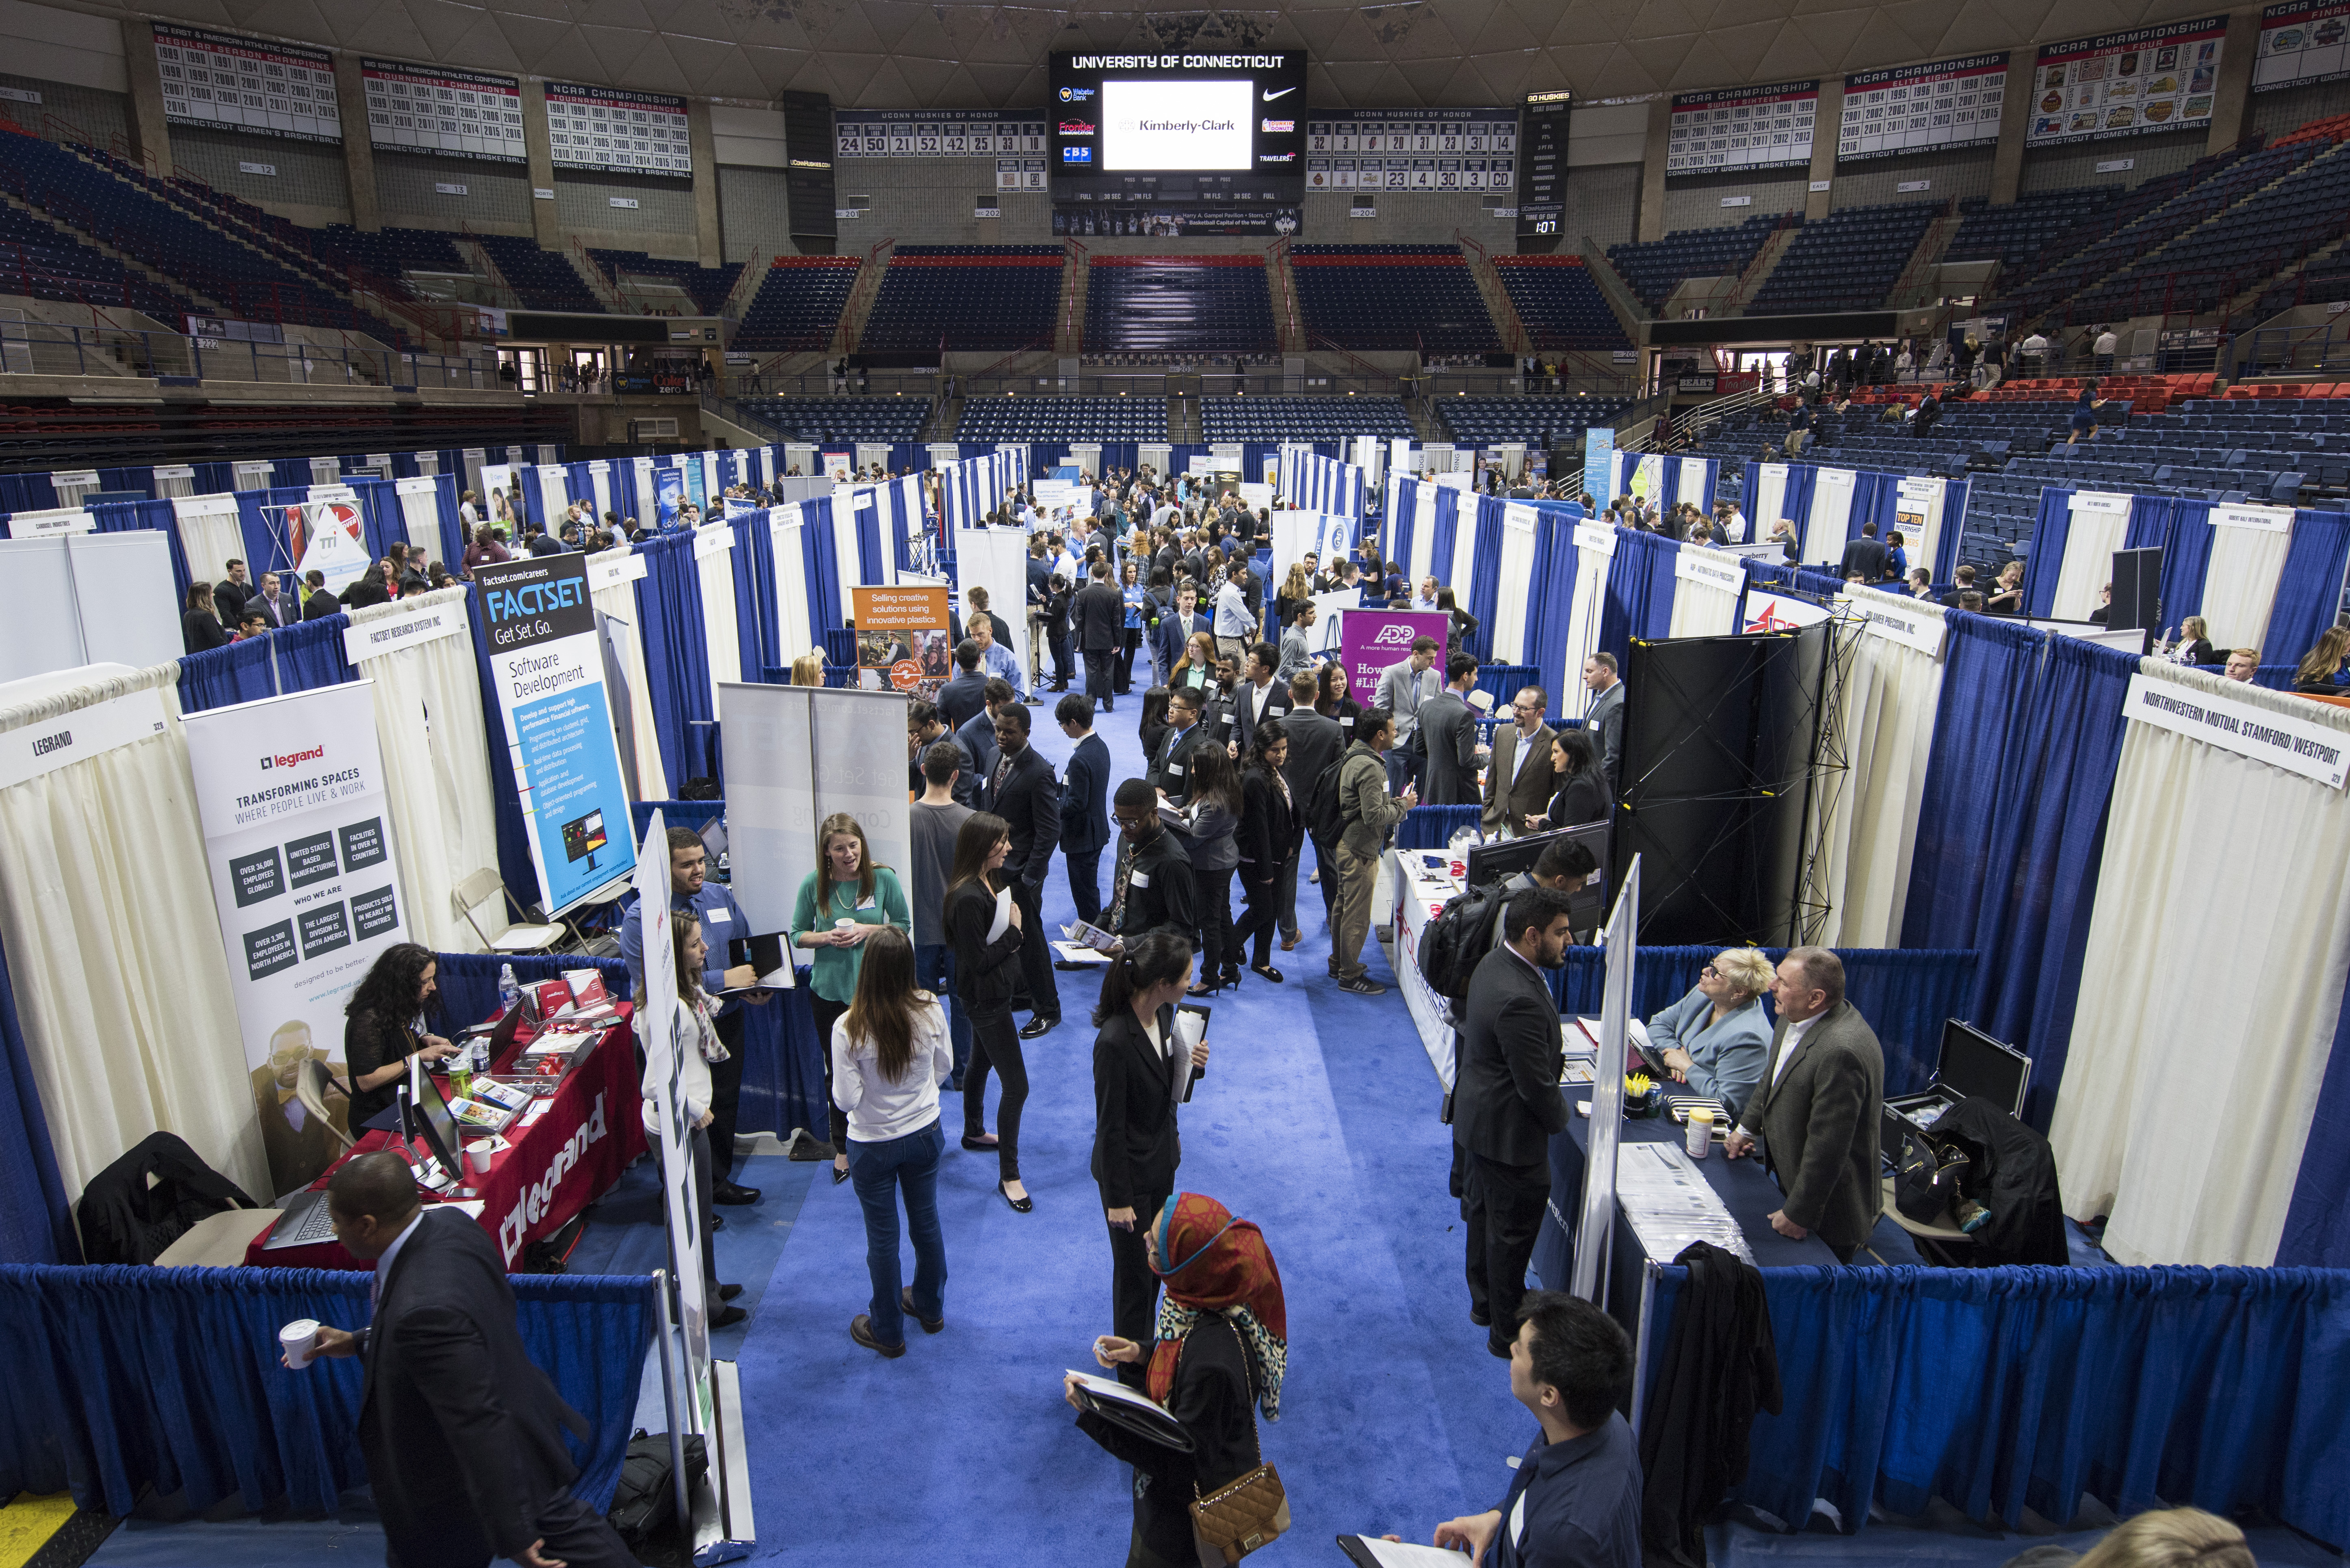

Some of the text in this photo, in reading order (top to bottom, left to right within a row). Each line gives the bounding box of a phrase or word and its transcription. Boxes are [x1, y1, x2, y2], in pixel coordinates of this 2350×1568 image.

[2049, 19, 2216, 54] NCAA CHAMPIONSHIP
[158, 37, 329, 70] REGULAR SEASON CHAMPIONS
[204, 34, 243, 45] AMERICAN
[245, 41, 280, 52] ATHLETIC
[283, 48, 328, 60] CONFERENCE
[2094, 40, 2163, 57] FINAL FOUR
[1073, 56, 1284, 68] UNIVERSITY OF CONNECTICUT
[1855, 56, 1999, 84] NCAA CHAMPIONSHIP
[1893, 73, 1955, 87] ELITE EIGHT
[553, 85, 678, 105] NCAA CHAMPIONSHIP
[1059, 122, 1095, 132] Frontier
[1140, 120, 1235, 133] Kimberly-Clark
[841, 138, 858, 151] 24
[867, 138, 884, 151] 50
[896, 138, 910, 151] 21
[921, 138, 937, 150] 52
[947, 138, 964, 150] 42
[975, 138, 988, 150] 25
[1003, 137, 1013, 150] 33
[1030, 137, 1038, 150] 10
[1536, 221, 1556, 233] 1:07
[654, 374, 685, 386] Coke
[1897, 513, 1923, 524] TOP TEN
[1895, 524, 1921, 533] INTERNSHIP
[483, 569, 548, 586] factset.com/careers
[487, 576, 583, 623] FACTSET
[872, 594, 897, 603] Selling
[909, 605, 929, 613] using
[907, 616, 936, 625] plastics
[1866, 611, 1915, 634] POLAMER PRECISION, INC.
[370, 616, 441, 644] FACTSET RESEARCH SYSTEM INC
[495, 620, 552, 644] Get Set. Go.
[1374, 625, 1414, 644] ADP
[509, 654, 559, 678] Software
[895, 663, 917, 671] Careers
[514, 665, 584, 698] Development
[520, 698, 575, 722] Develop and support high
[154, 722, 163, 731] 328
[2143, 691, 2340, 766] NORTHWESTERN MUTUAL STAMFORD/WESTPORT
[32, 731, 72, 756] LEGRAND
[274, 745, 323, 768] legrand
[2331, 774, 2340, 784] 329
[236, 768, 360, 808] TRANSFORMING SPACES
[235, 781, 366, 824] WHERE PEOPLE LIVE & WORK
[294, 885, 342, 905] WHO WE ARE
[520, 1092, 607, 1233] legrand
